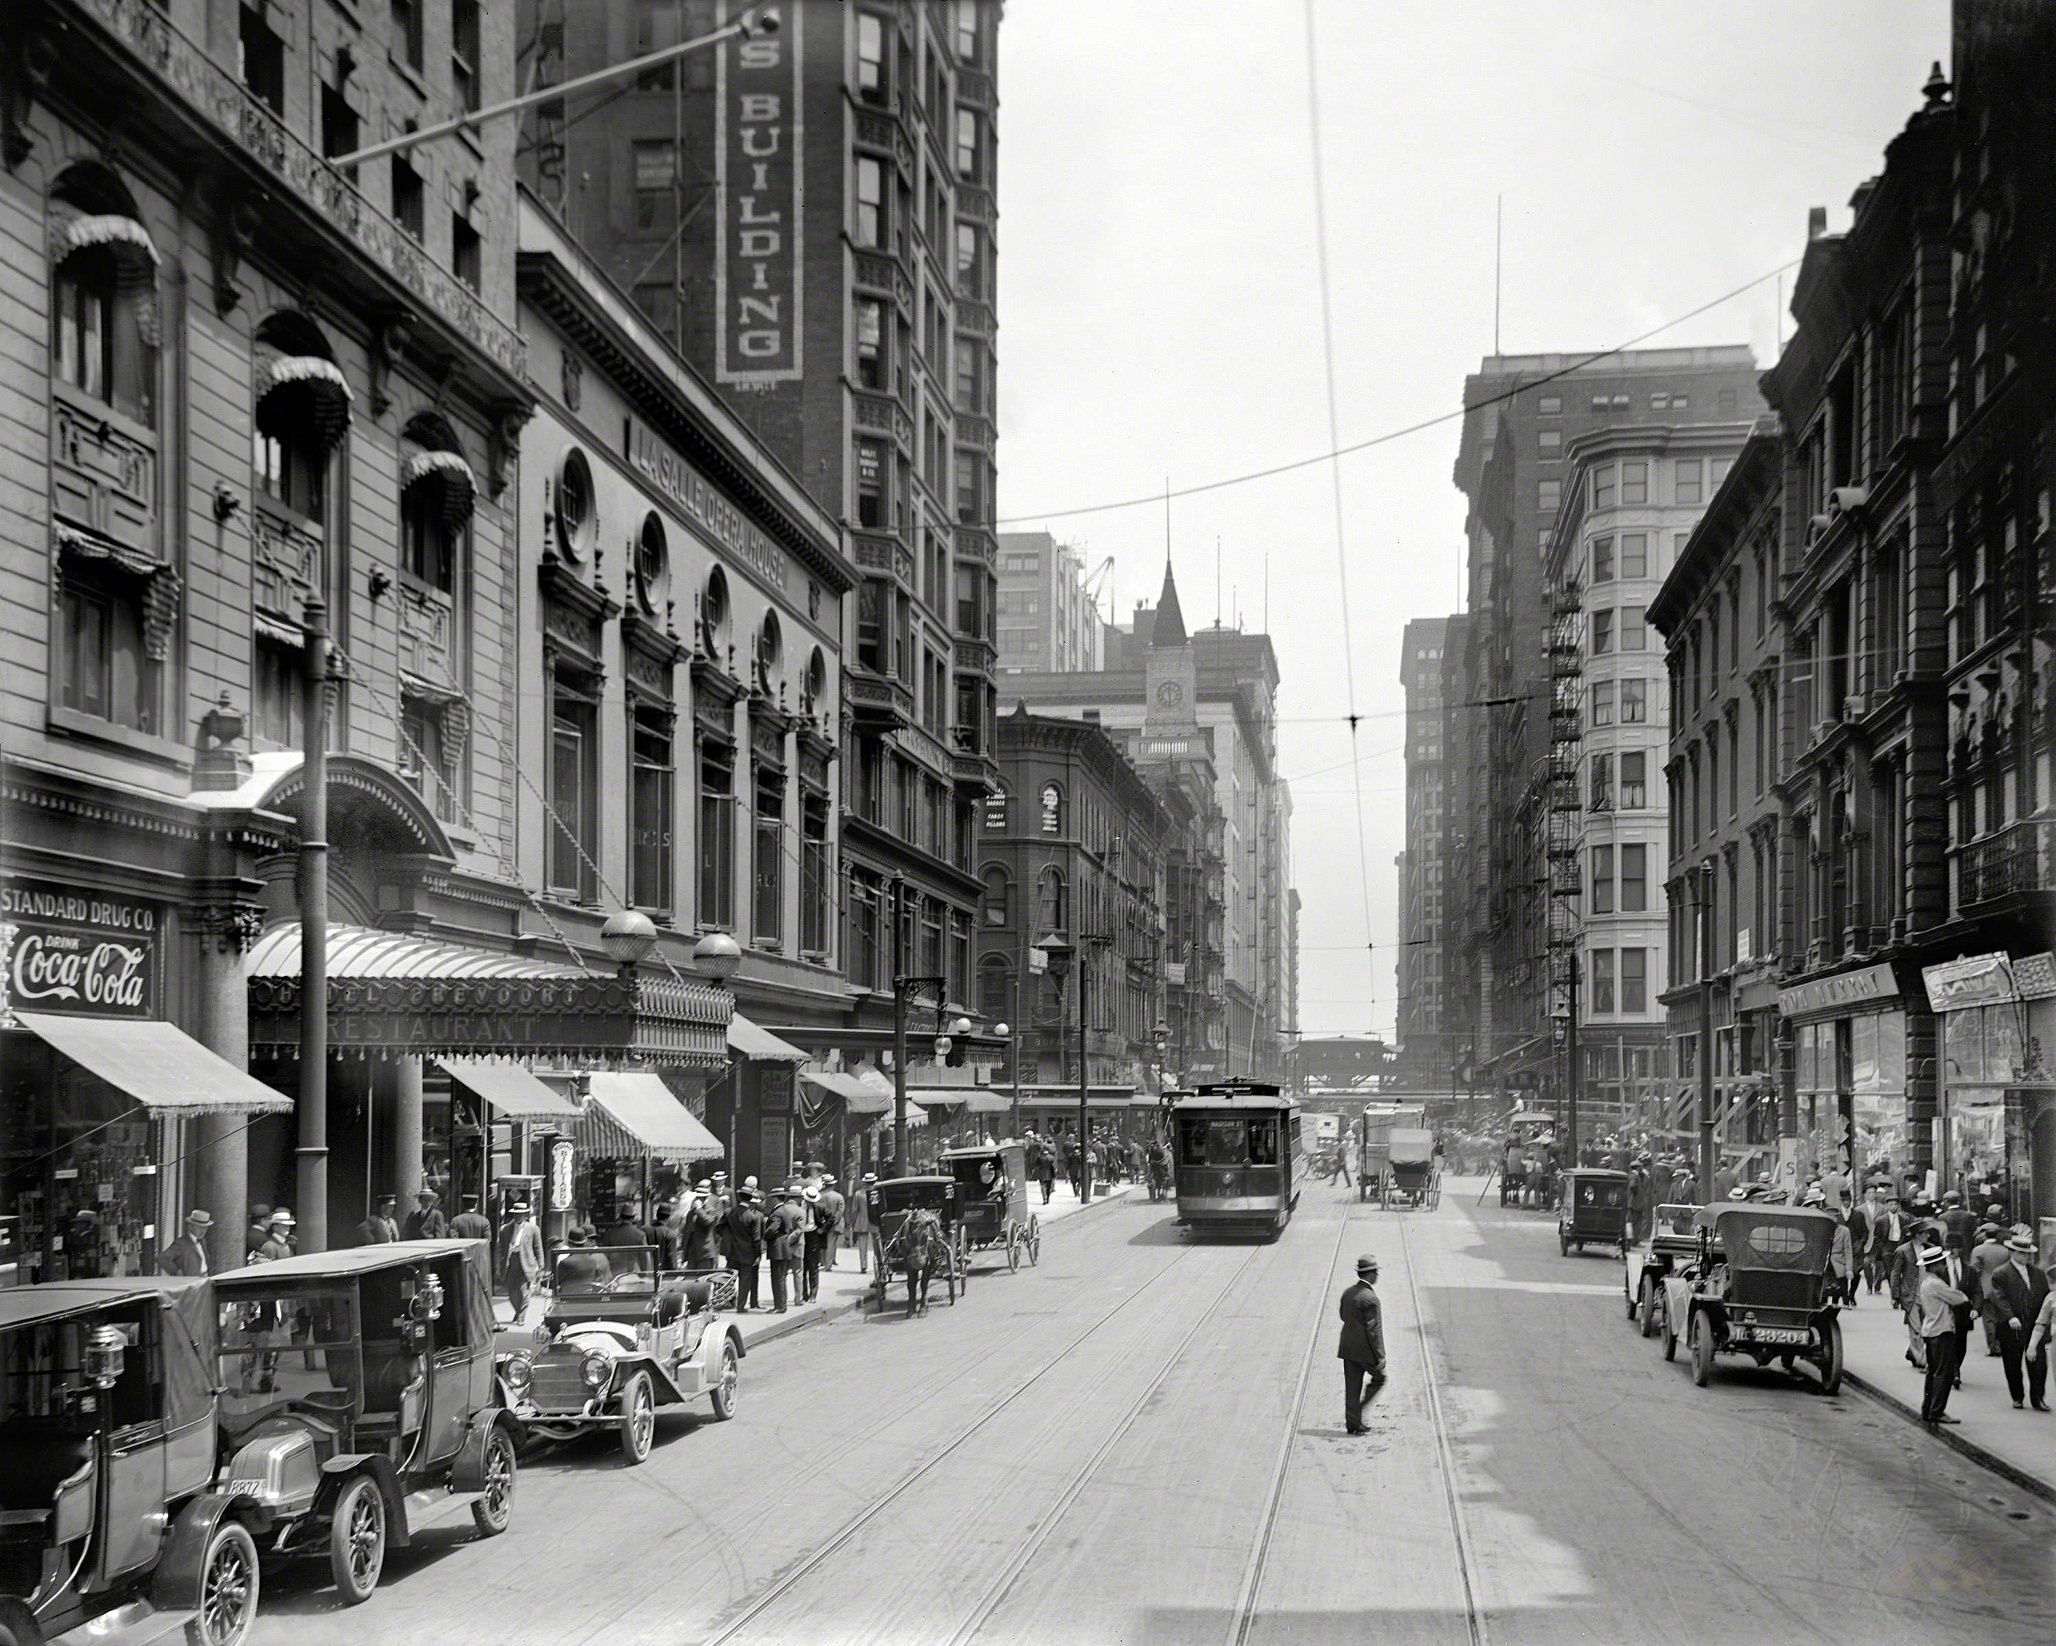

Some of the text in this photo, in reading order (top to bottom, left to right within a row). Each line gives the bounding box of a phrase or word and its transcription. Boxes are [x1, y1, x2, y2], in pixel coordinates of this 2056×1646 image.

[739, 94, 781, 358] BUILDING
[706, 492, 745, 557] OPERA
[748, 530, 784, 588] HOUSE
[1, 888, 156, 931] STANDARD DRUG CO.
[45, 935, 80, 950] DRINK
[13, 935, 145, 1006] Coca-Cola
[1780, 971, 1879, 1011] TOM MURRAY
[280, 985, 377, 1002] HTEL
[326, 1016, 537, 1041] RESTAURANT
